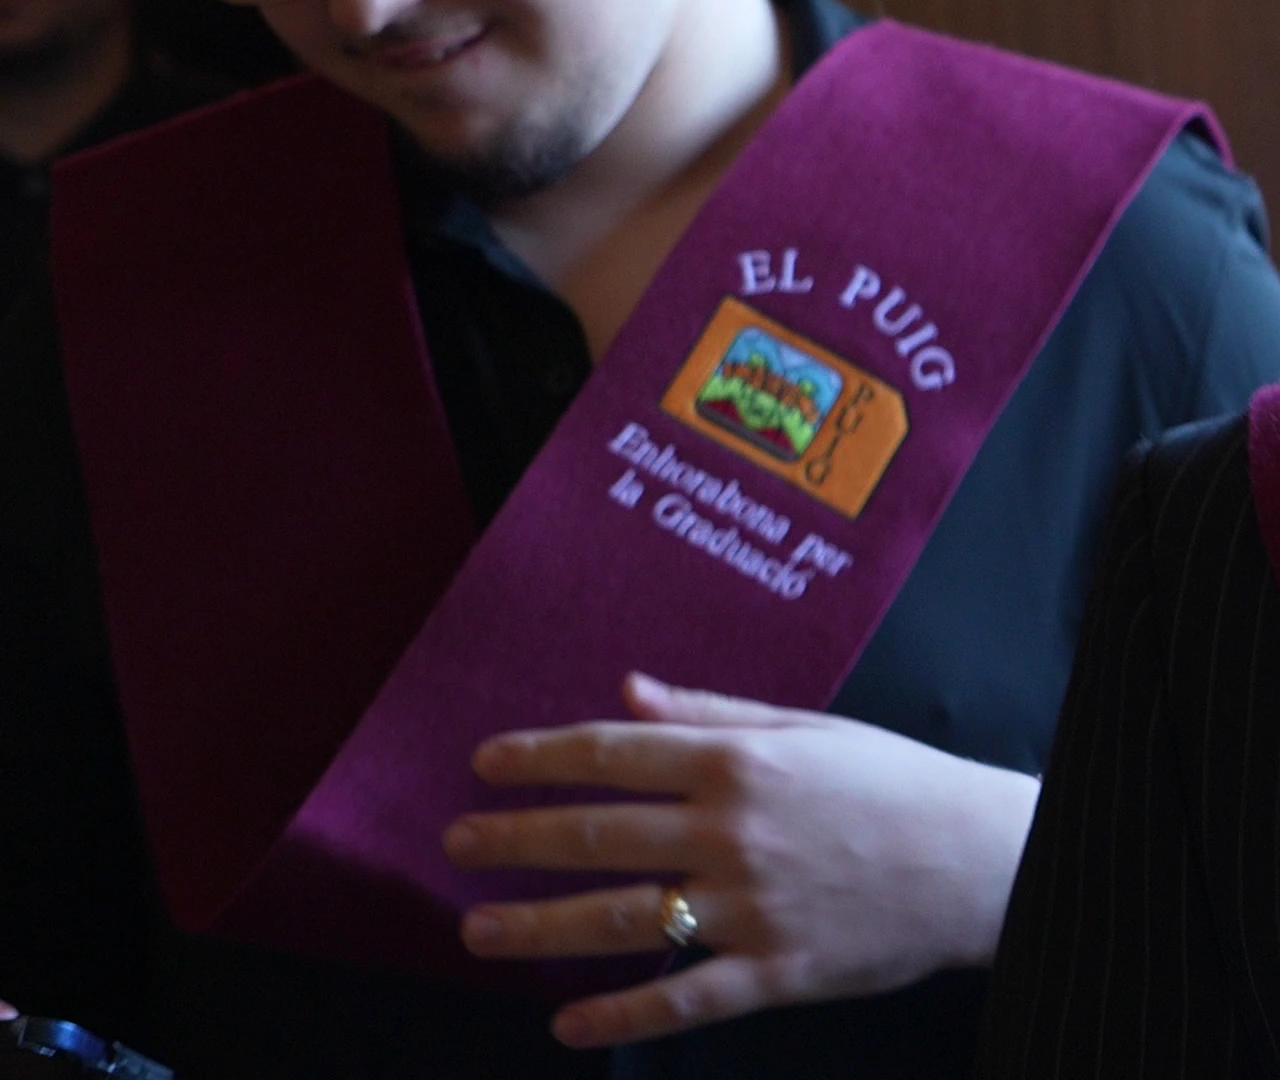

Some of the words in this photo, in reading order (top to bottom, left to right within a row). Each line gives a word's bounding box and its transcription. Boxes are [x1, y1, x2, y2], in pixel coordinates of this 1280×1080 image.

[738, 248, 813, 295] EL
[839, 264, 956, 391] PUIG
[607, 422, 791, 544] Enhorabona
[789, 533, 853, 577] per
[609, 468, 646, 509] la
[652, 493, 816, 600] Graduació
